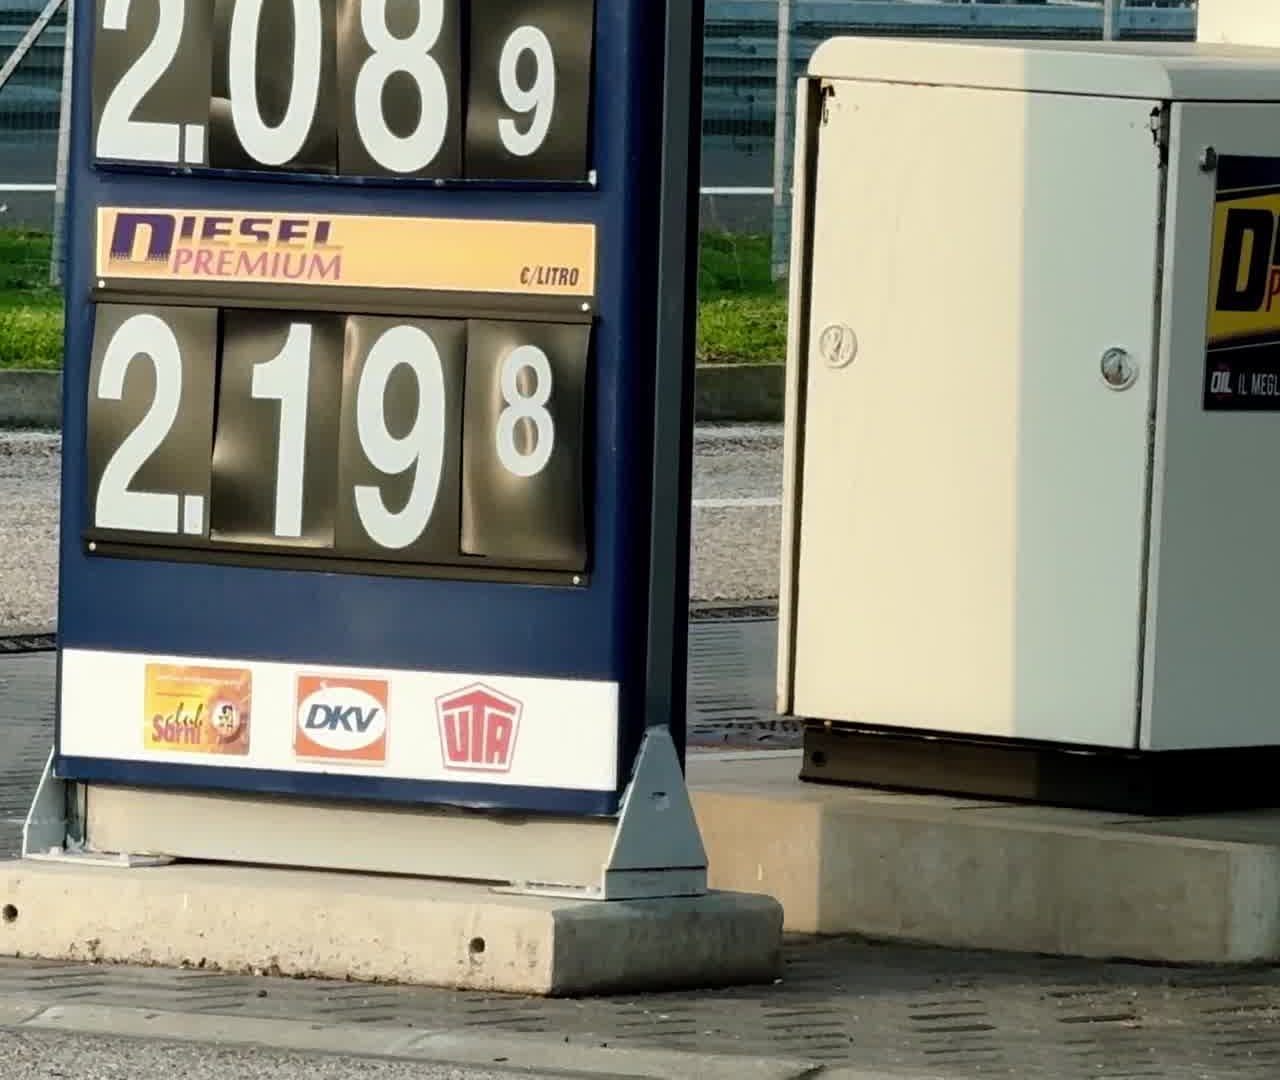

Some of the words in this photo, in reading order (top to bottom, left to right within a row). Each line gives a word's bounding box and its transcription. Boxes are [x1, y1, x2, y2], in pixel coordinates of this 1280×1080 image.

[171, 247, 342, 281] PREMIUM
[1238, 372, 1248, 395] IL
[304, 704, 379, 734] DKV
[442, 690, 517, 765] UTA
